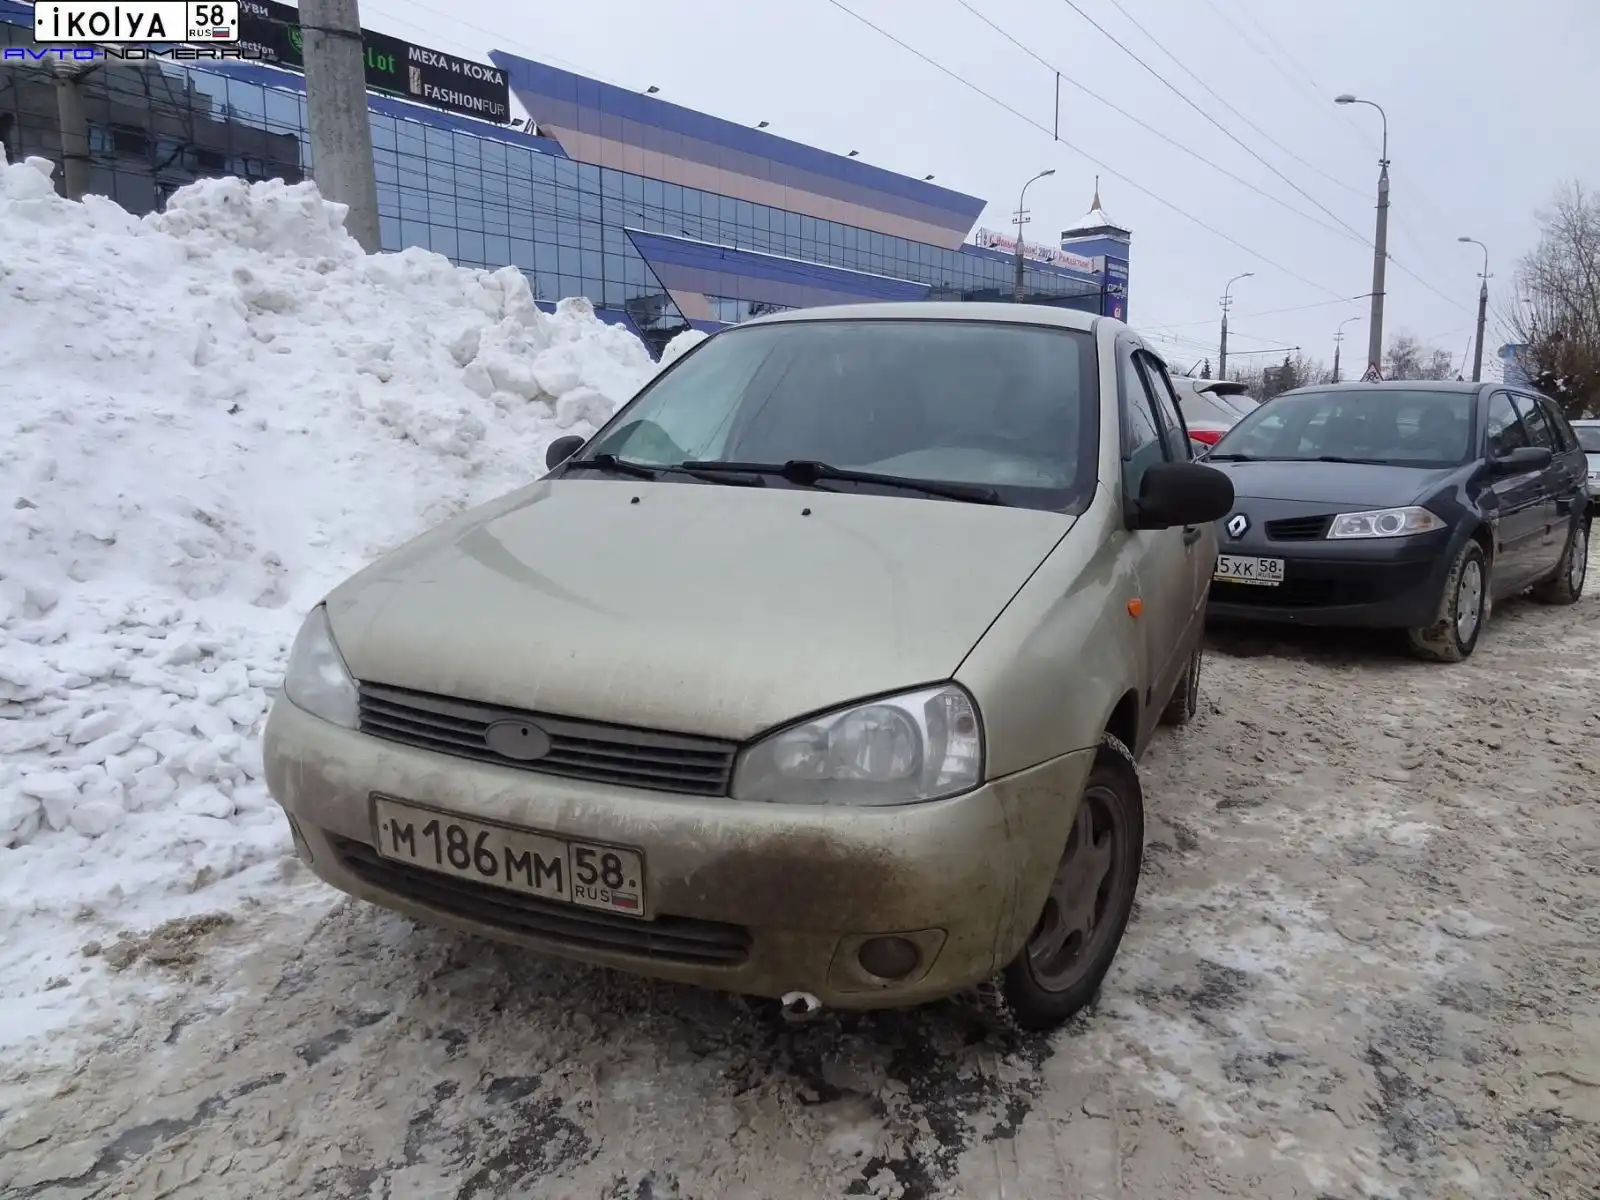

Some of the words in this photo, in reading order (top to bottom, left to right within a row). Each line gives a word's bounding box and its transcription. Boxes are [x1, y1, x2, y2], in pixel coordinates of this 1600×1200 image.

[408, 46, 449, 71] МЕХА
[463, 62, 504, 87] КОЖА
[1260, 559, 1278, 573] 58
[575, 847, 624, 890] 58
[575, 884, 610, 903] RUS
